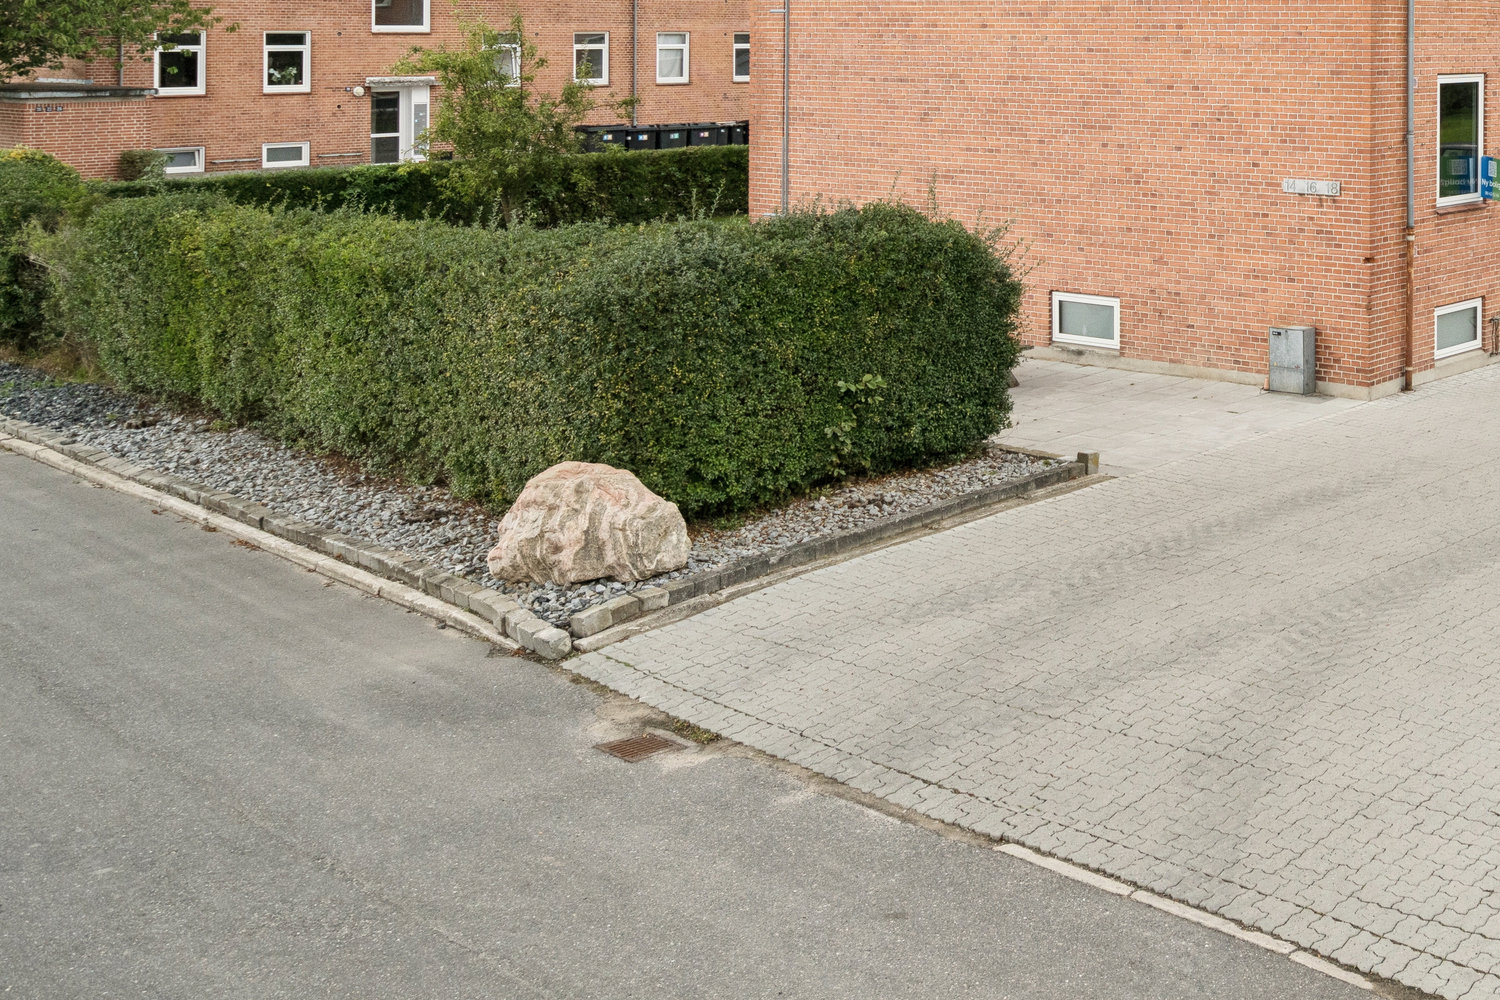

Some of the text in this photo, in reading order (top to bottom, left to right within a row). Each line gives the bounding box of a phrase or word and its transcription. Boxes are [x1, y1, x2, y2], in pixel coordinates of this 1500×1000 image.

[1285, 180, 1338, 194] 14 16 18
[1481, 178, 1489, 187] Ny
